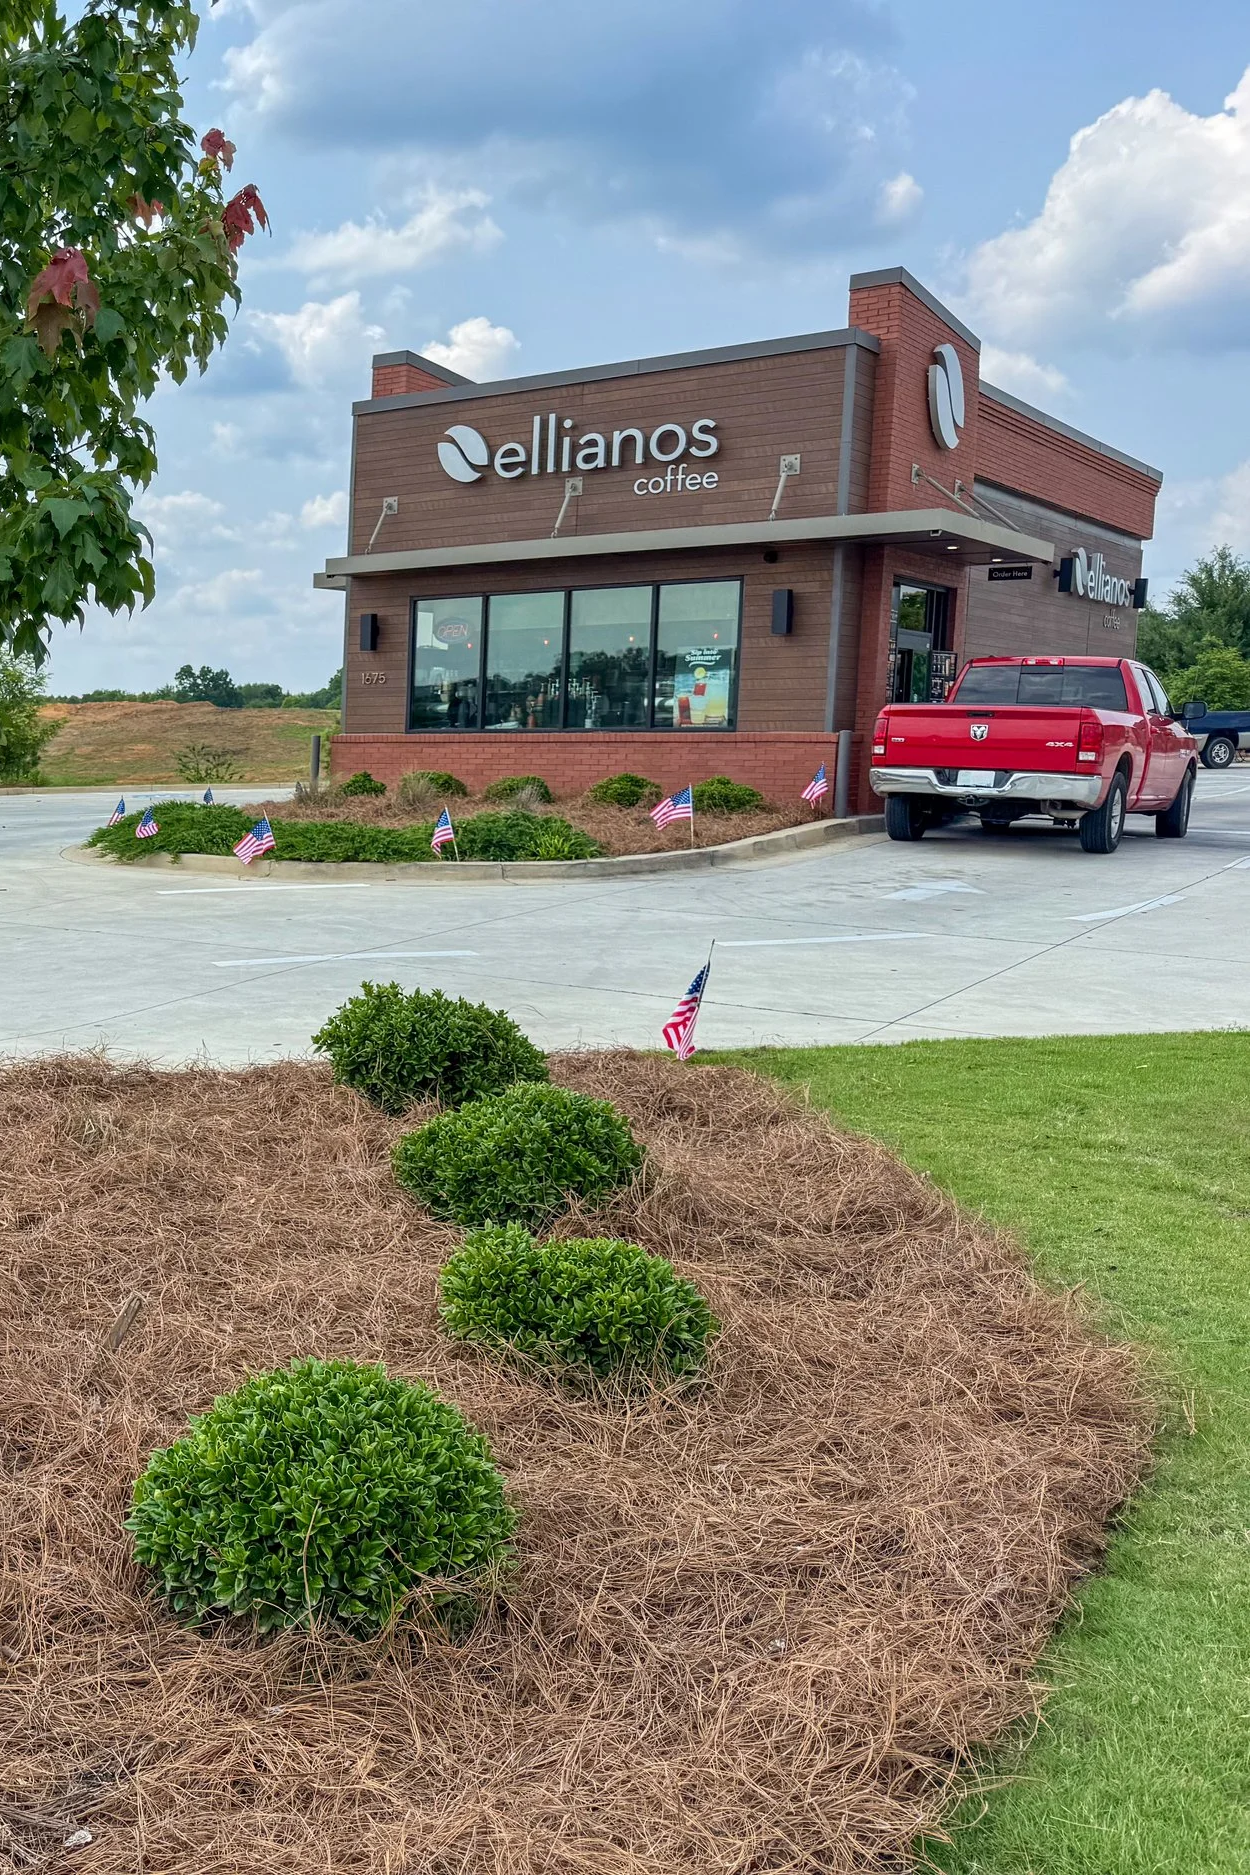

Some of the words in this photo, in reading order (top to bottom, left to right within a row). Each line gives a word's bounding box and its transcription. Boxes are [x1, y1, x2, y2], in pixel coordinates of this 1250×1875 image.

[494, 413, 719, 479] ellianos
[634, 464, 719, 495] coffee
[1087, 553, 1131, 607] ellianos
[437, 624, 469, 639] OPEN
[1104, 609, 1121, 630] coffee
[361, 672, 386, 684] 1675
